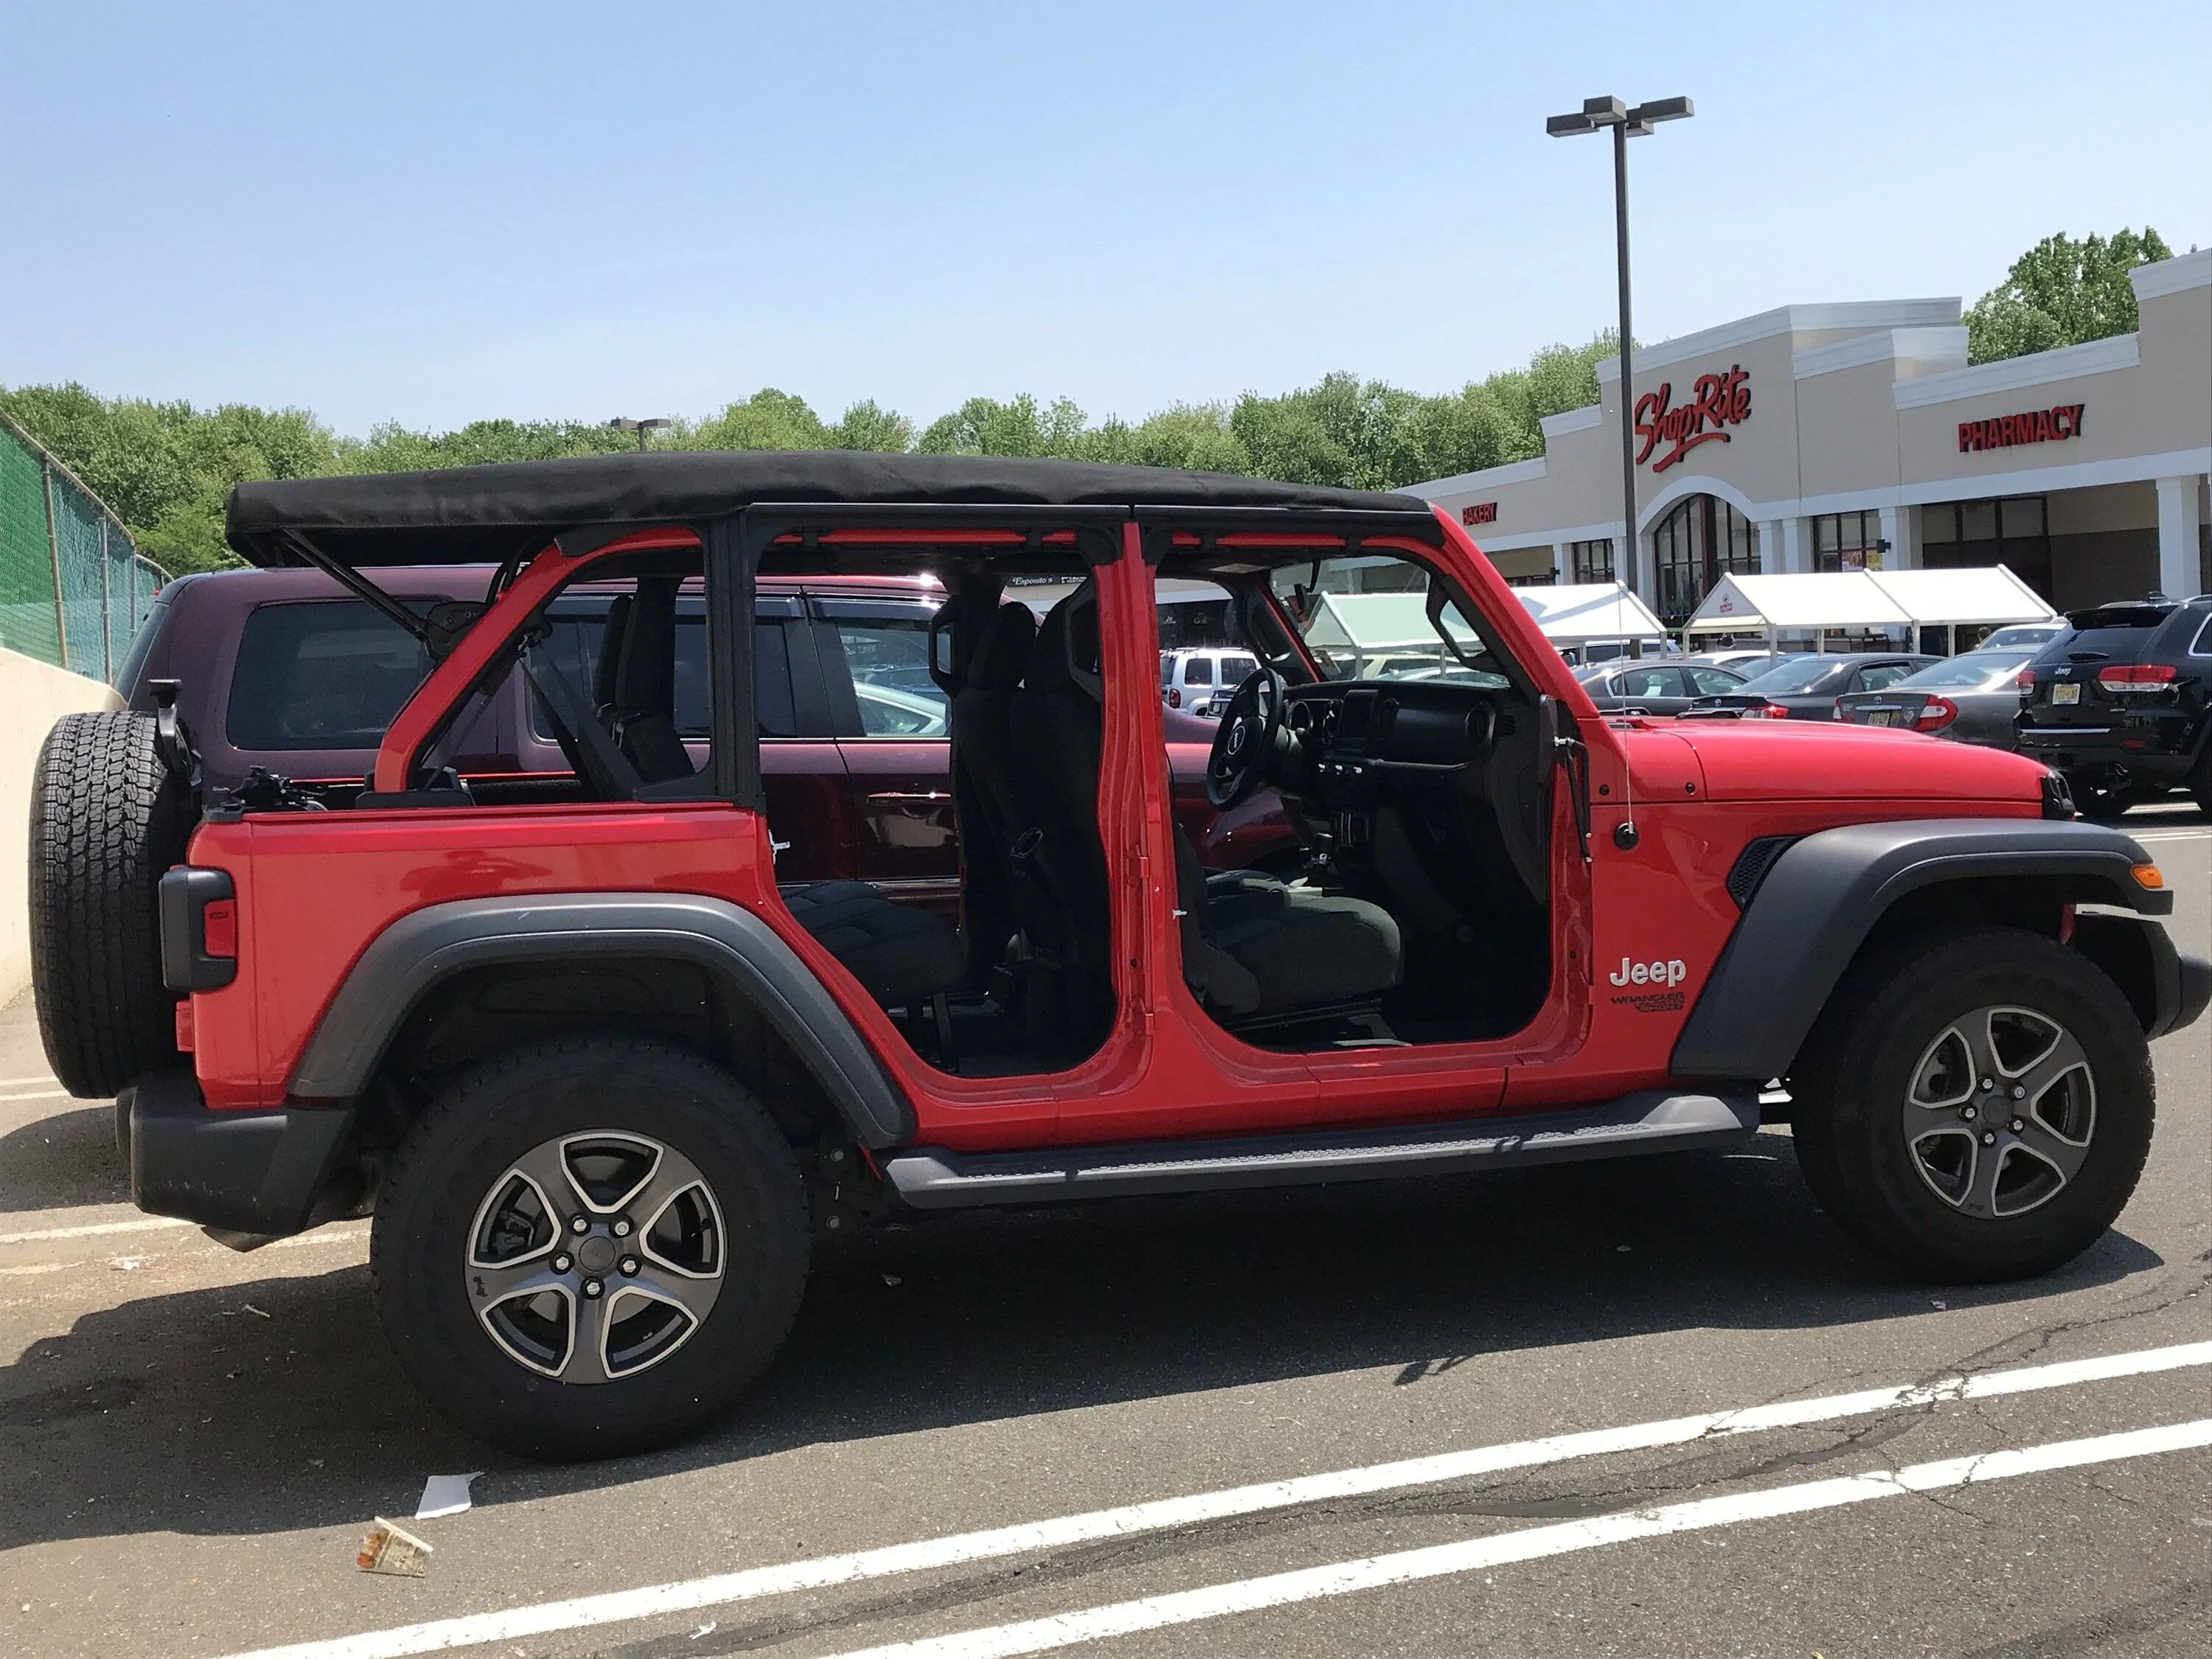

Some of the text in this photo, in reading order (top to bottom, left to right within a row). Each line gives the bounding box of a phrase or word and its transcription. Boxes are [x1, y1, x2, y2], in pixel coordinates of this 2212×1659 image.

[1634, 364, 1752, 469] ShopRite
[1958, 404, 2085, 453] PHARMACY
[1462, 502, 1498, 526] BAKERY
[1610, 957, 1686, 987] Jeep
